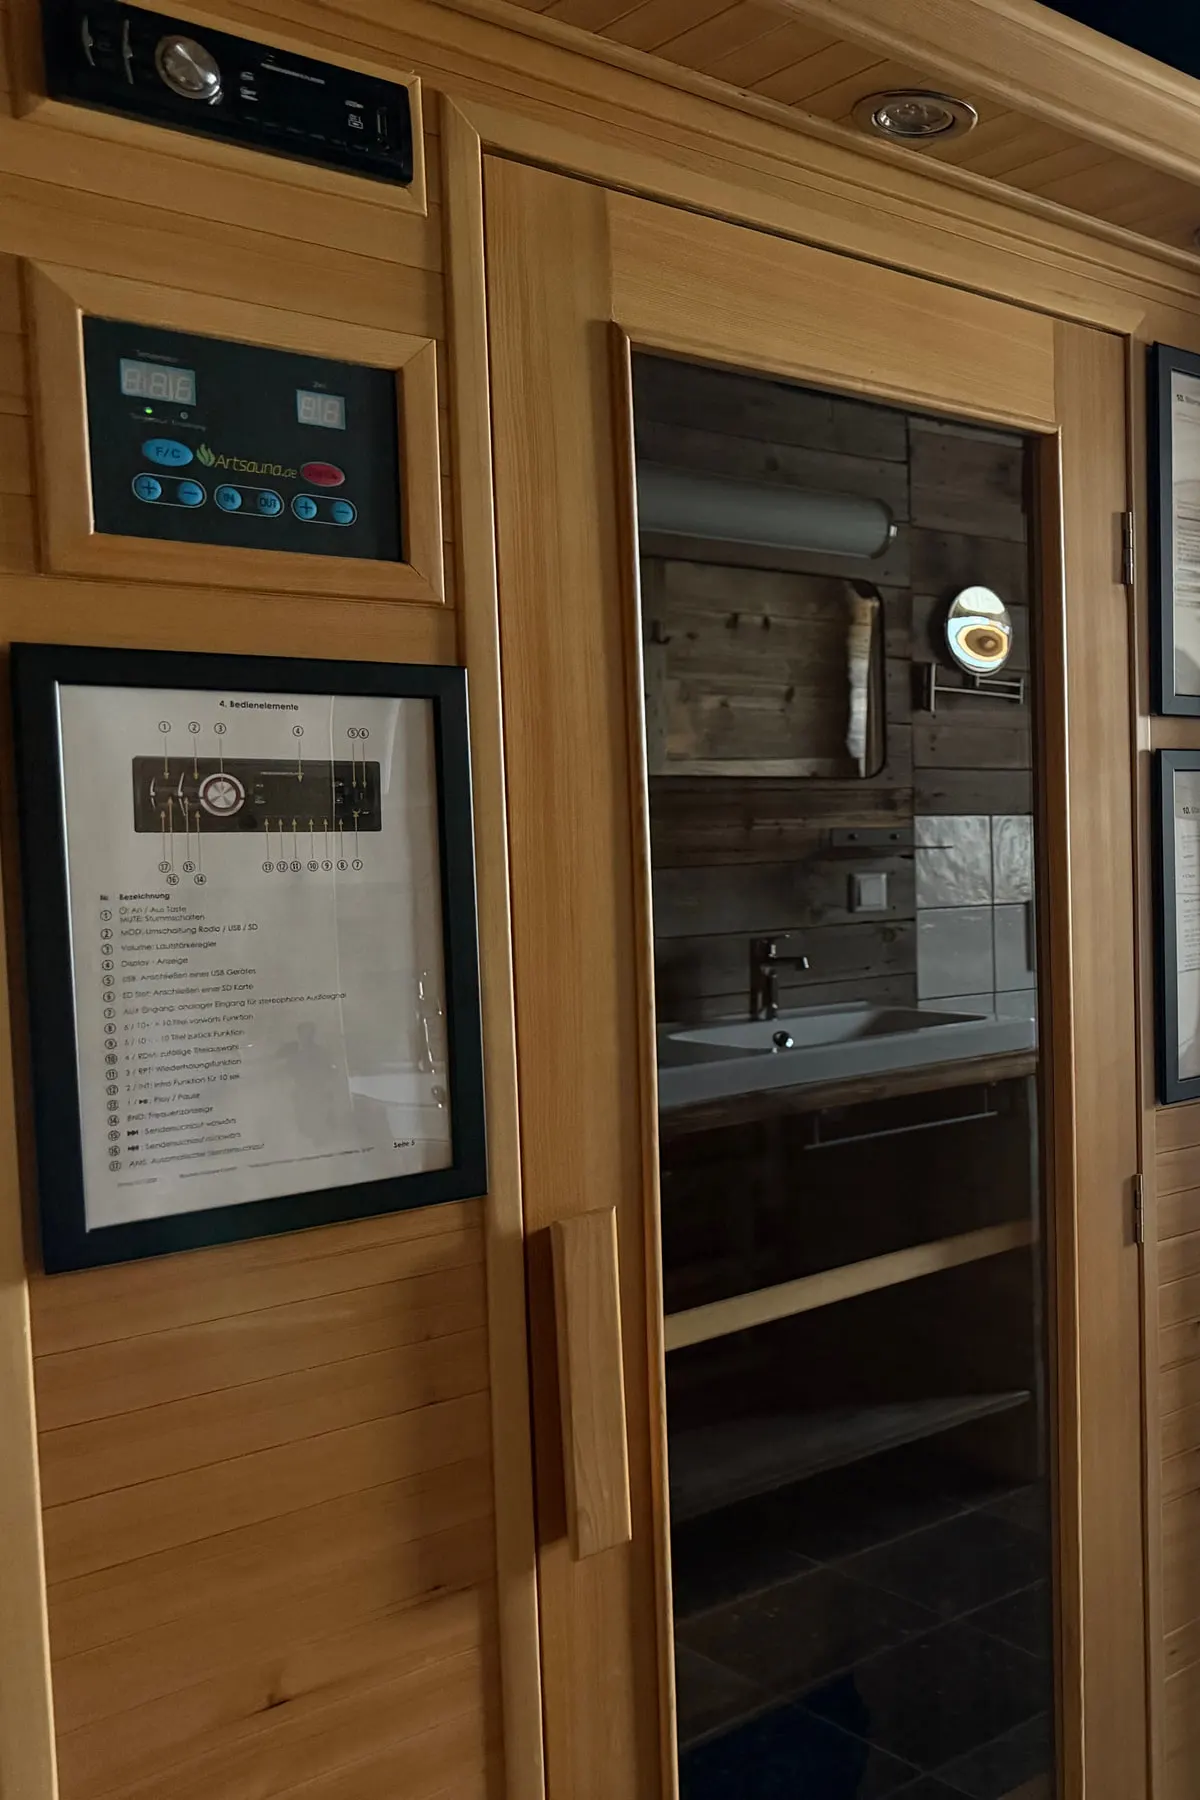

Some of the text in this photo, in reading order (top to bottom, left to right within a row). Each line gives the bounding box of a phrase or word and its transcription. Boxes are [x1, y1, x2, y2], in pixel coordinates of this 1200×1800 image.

[156, 447, 181, 459] F/C
[214, 454, 297, 479] Artsauna.de
[223, 493, 235, 503] IN
[259, 495, 277, 509] OUT
[219, 700, 299, 711] 4. Bedienelemente
[119, 893, 171, 901] Bezeichnung
[145, 926, 197, 935] Umschaltung
[198, 925, 221, 933] Radio
[228, 924, 242, 932] USB
[247, 923, 259, 931] SD
[156, 957, 189, 966] Anzeige
[211, 969, 225, 977] USB
[221, 984, 232, 992] SD
[233, 983, 254, 991] Karte
[214, 1000, 245, 1009] Eingang
[222, 1013, 254, 1022] Funktion
[213, 1029, 245, 1038] Funktion
[173, 1077, 206, 1086] Funktion
[219, 1073, 228, 1081] 10
